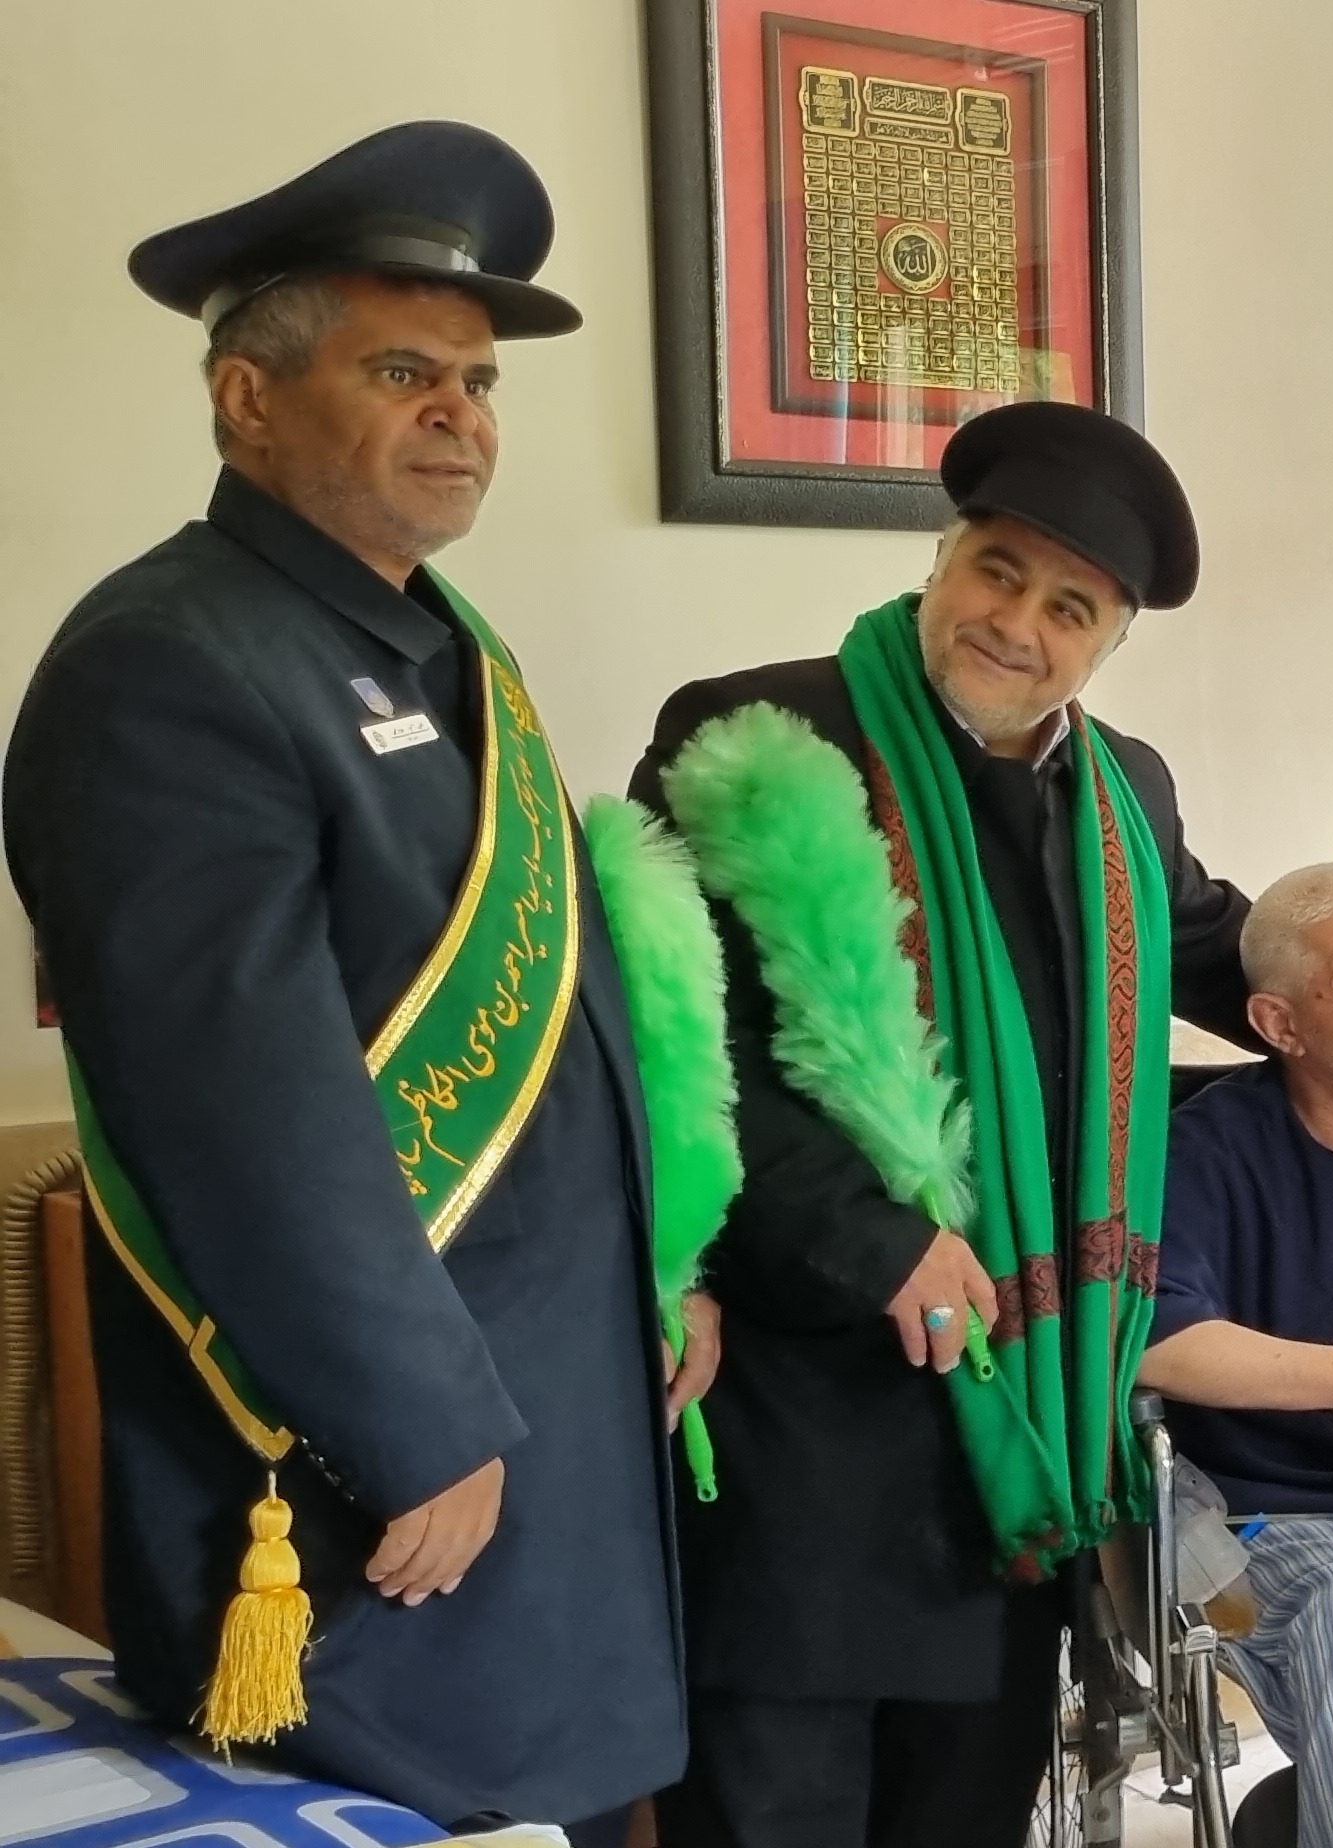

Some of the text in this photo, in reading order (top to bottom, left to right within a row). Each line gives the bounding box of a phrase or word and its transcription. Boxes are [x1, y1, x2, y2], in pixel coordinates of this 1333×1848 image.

[897, 241, 932, 278] الله
[503, 940, 526, 994] احمد
[492, 980, 530, 1028] بن
[462, 1007, 497, 1078] موسی
[398, 1062, 466, 1168] الکاظم
